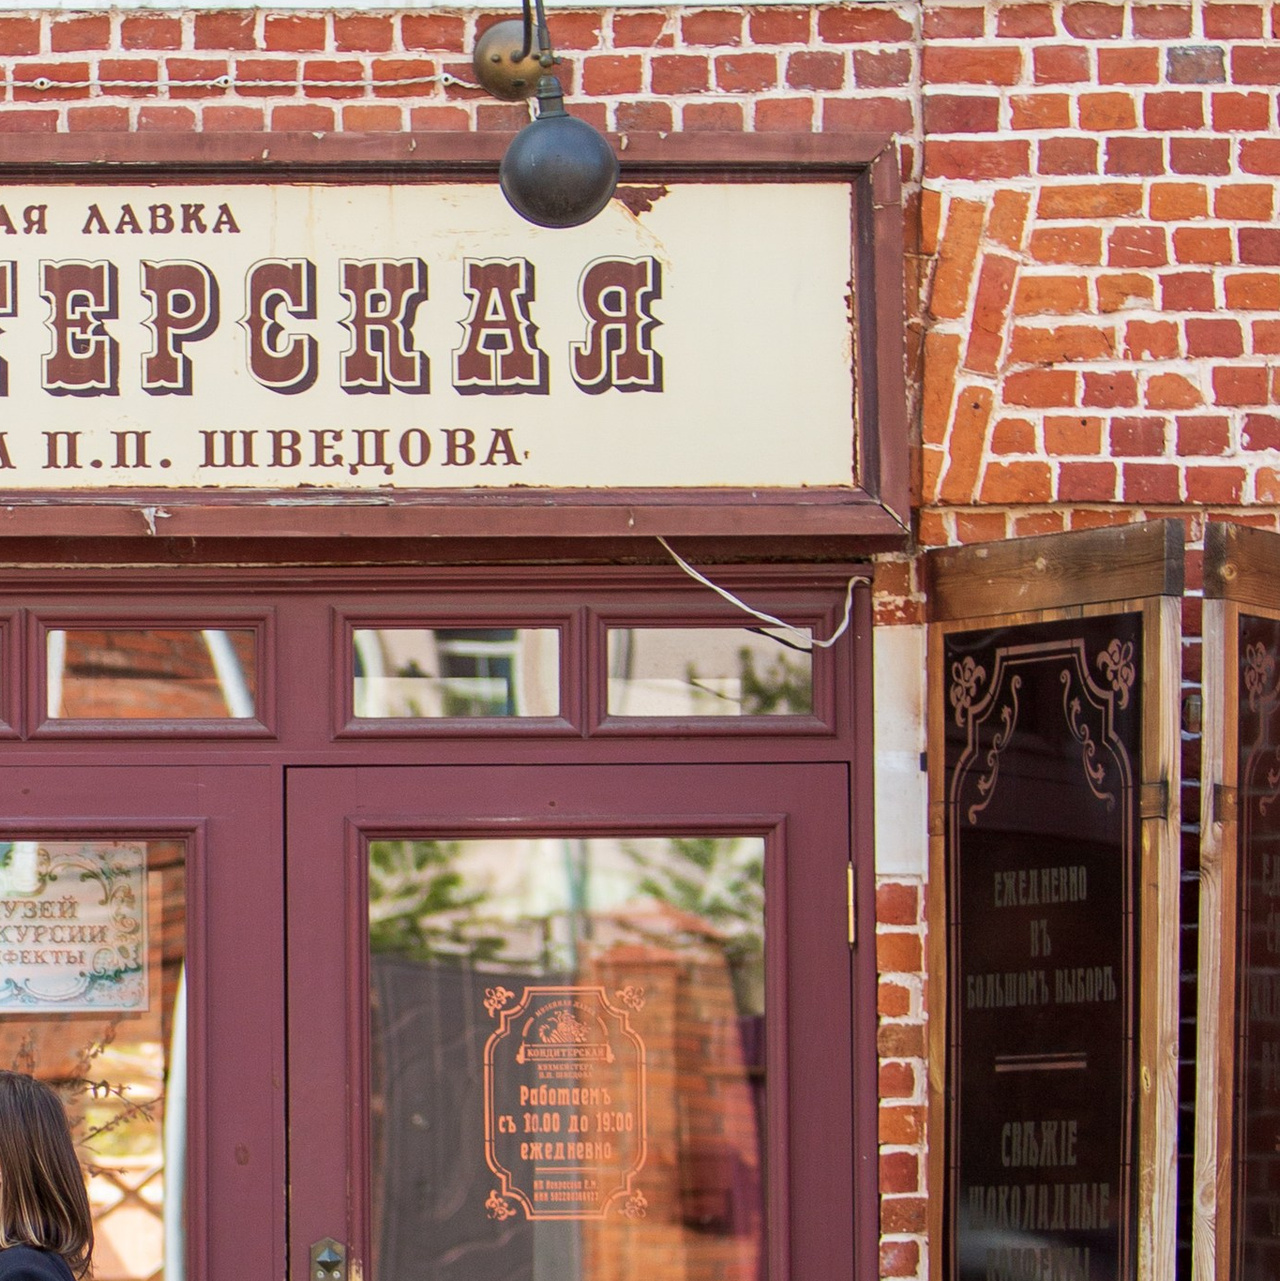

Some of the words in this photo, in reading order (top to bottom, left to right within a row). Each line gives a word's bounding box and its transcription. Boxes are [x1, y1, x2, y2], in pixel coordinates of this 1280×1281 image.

[81, 202, 241, 235] ЛАВКА
[42, 429, 173, 471] П.П.
[198, 428, 523, 475] ШВЕДОВА
[993, 865, 1088, 907] ЕЖЕДНЕВНО
[966, 970, 1049, 1008] БОЛЬШОМЪ
[527, 1049, 605, 1059] КОНДИТЕРСКАЯ
[520, 1084, 611, 1106] Работаемъ
[498, 1113, 517, 1133] съ
[567, 1113, 588, 1134] до
[520, 1141, 611, 1160] ежедневно
[969, 1183, 1110, 1231] ШОКОЛАДНЫЕ
